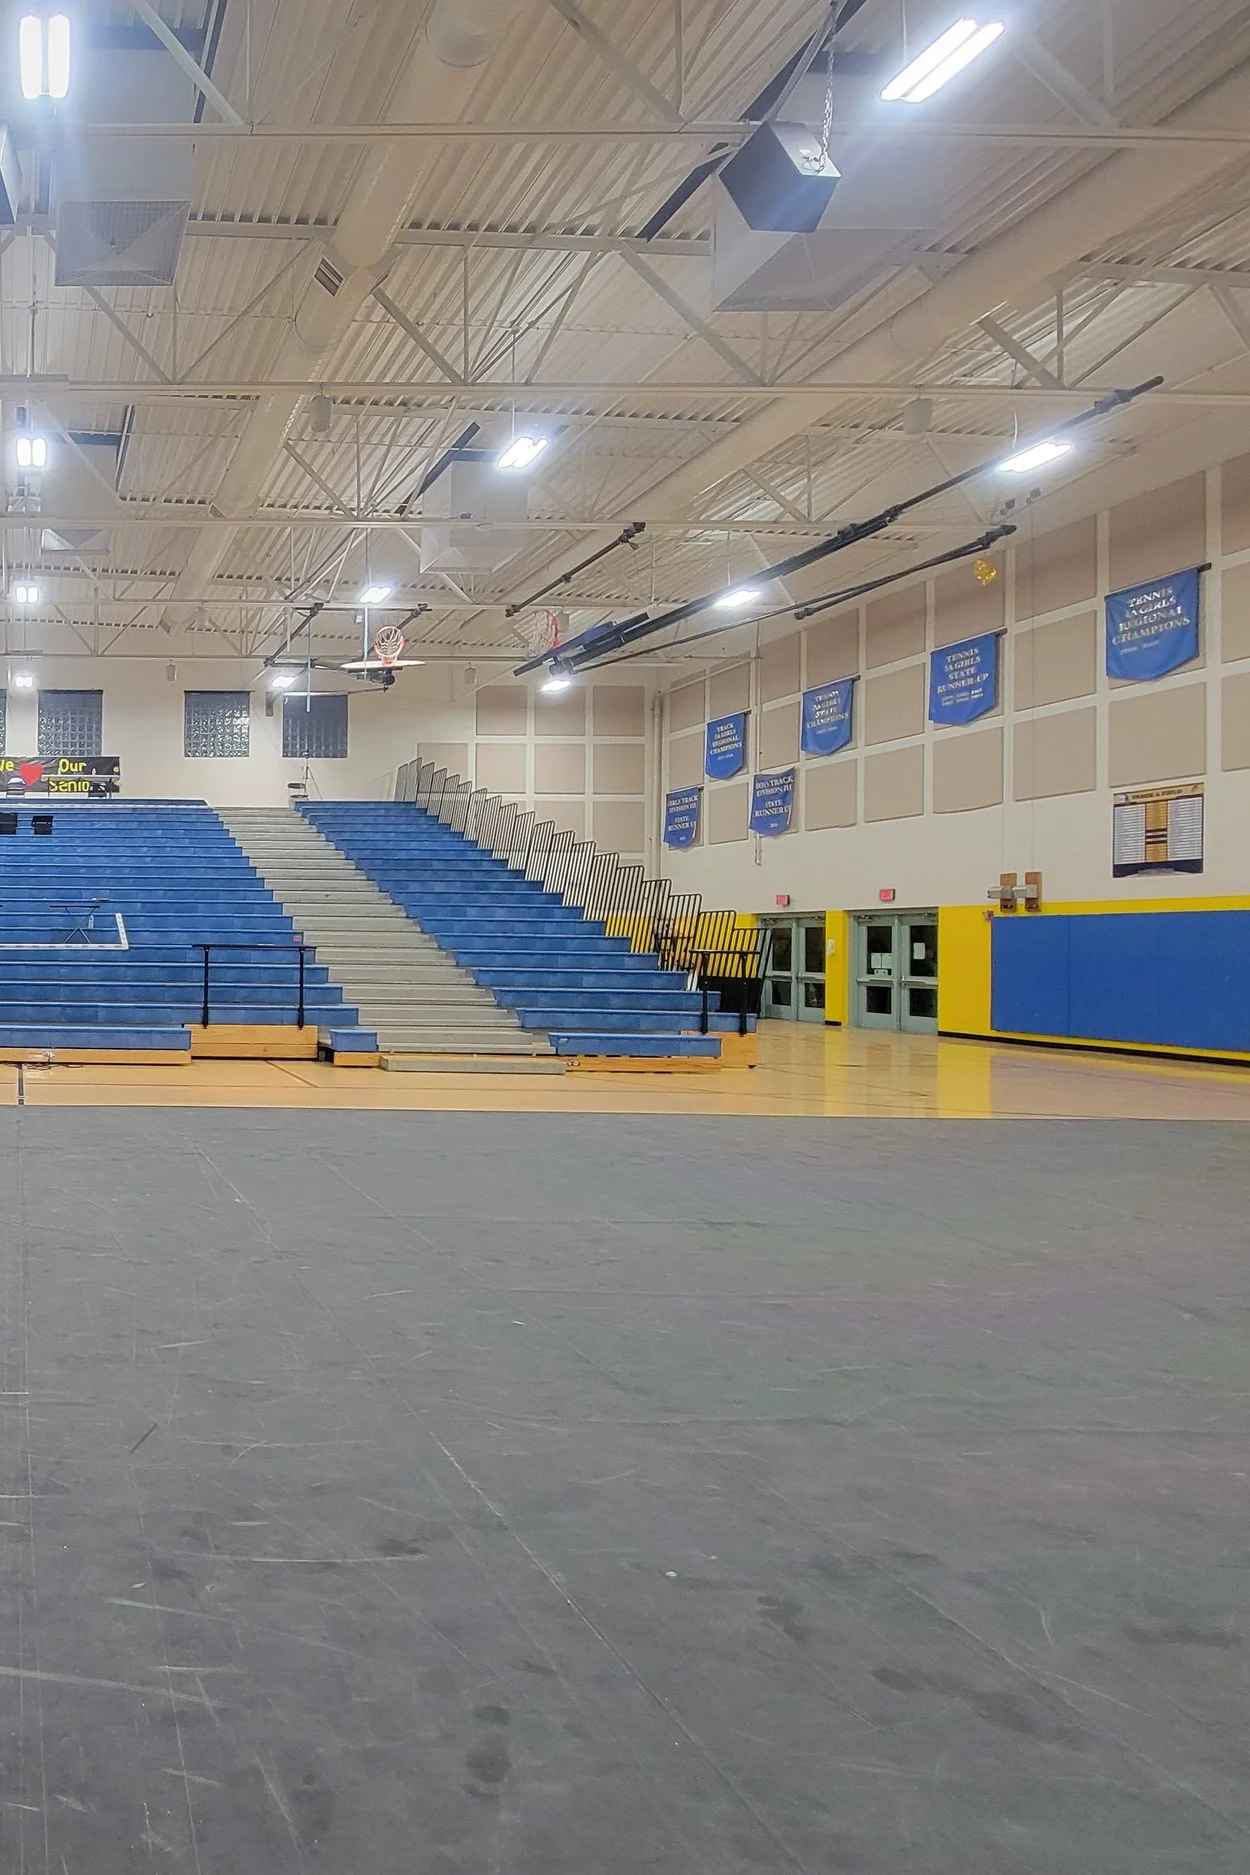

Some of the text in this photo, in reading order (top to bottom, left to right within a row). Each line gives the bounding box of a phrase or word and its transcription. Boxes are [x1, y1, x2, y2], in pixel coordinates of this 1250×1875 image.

[1128, 587, 1173, 608] TENNIS
[1118, 605, 1182, 631] REGIONAL
[1112, 616, 1191, 645] CHAMPIONS
[945, 647, 980, 663] TENNIS
[954, 655, 981, 669] GIRLS
[948, 666, 977, 680] STATE
[59, 758, 87, 773] Our
[770, 776, 794, 787] TRACK
[755, 806, 784, 817] RUNNER
